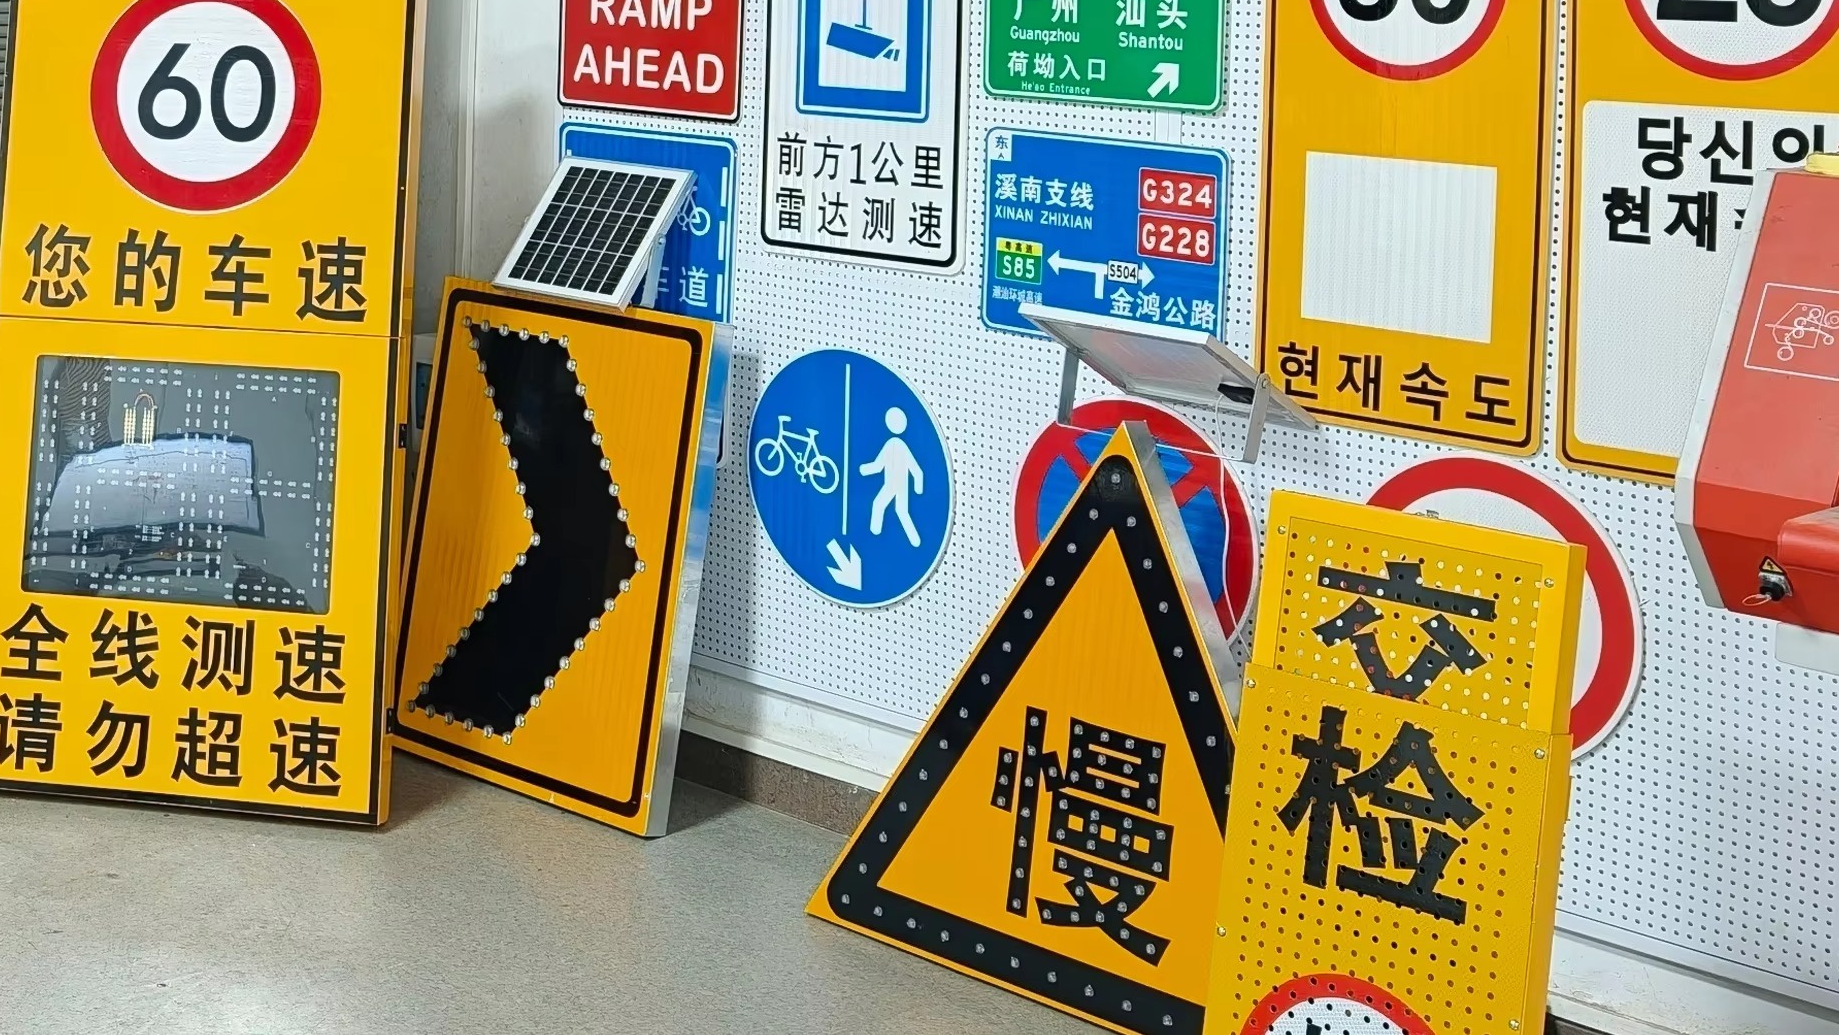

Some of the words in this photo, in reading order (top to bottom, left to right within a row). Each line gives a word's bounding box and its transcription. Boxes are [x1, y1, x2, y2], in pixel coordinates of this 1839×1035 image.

[1010, 25, 1080, 45] Guangzhou
[1118, 31, 1184, 51] Shantou
[572, 46, 725, 95] AHEAD
[1007, 50, 1106, 81] 荷坳入口
[137, 43, 276, 142] 60
[1049, 82, 1091, 95] Entrance
[776, 131, 944, 192] 前方1公里
[995, 134, 1009, 150] 东
[994, 173, 1094, 211] 溪南支线
[1142, 178, 1213, 209] G324
[775, 188, 944, 251] 雷达测速
[994, 204, 1034, 223] XINAN
[1040, 210, 1093, 230] ZHIXIAN
[1602, 185, 1748, 252] 현재
[1141, 222, 1210, 258] G228
[21, 223, 369, 323] 您的车速
[1002, 255, 1035, 279] S85
[1109, 263, 1137, 281] S504
[1109, 286, 1216, 330] 金鸿公路
[1277, 340, 1518, 428] 현재속도
[0, 603, 347, 706] 全线测速
[1277, 560, 1497, 927] 交检
[990, 706, 1176, 967] 慢
